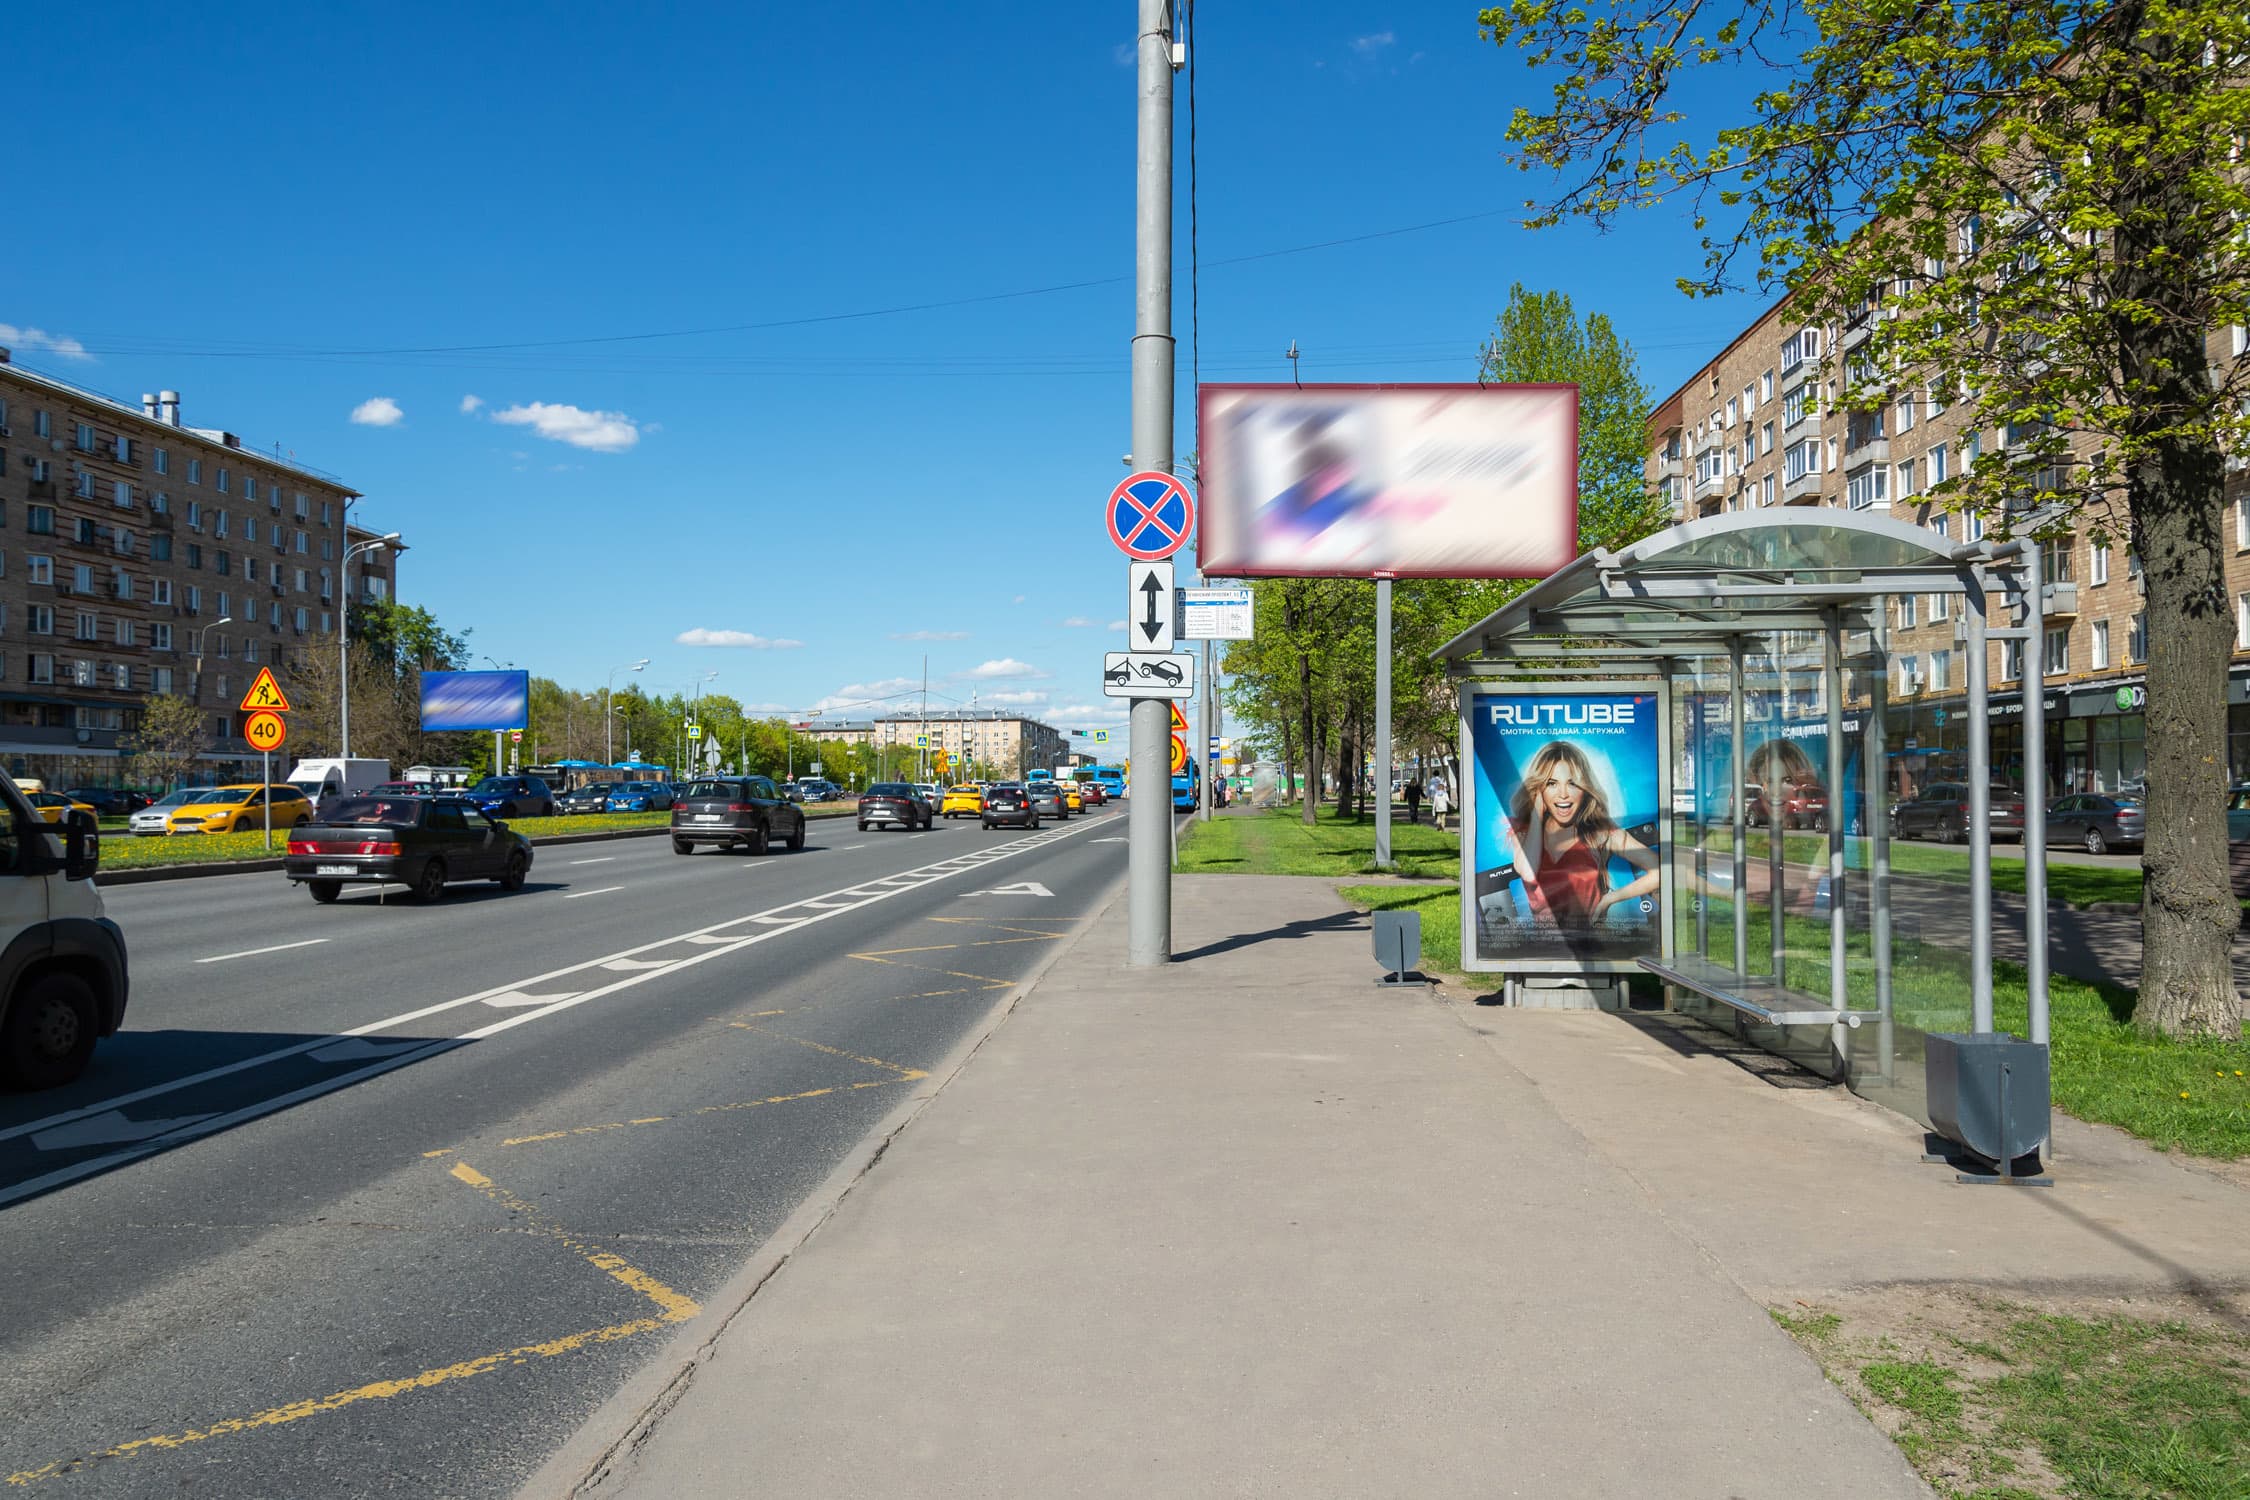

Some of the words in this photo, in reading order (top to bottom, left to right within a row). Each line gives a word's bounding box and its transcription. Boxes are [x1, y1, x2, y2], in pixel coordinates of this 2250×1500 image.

[1491, 704, 1635, 725] RUTUBE
[253, 723, 276, 738] 40
[1500, 728, 1535, 736] СМОТРИ.
[1536, 727, 1581, 736] СОЗДАВАЙ.
[1582, 726, 1627, 735] ЗАГРУЖАЙ.
